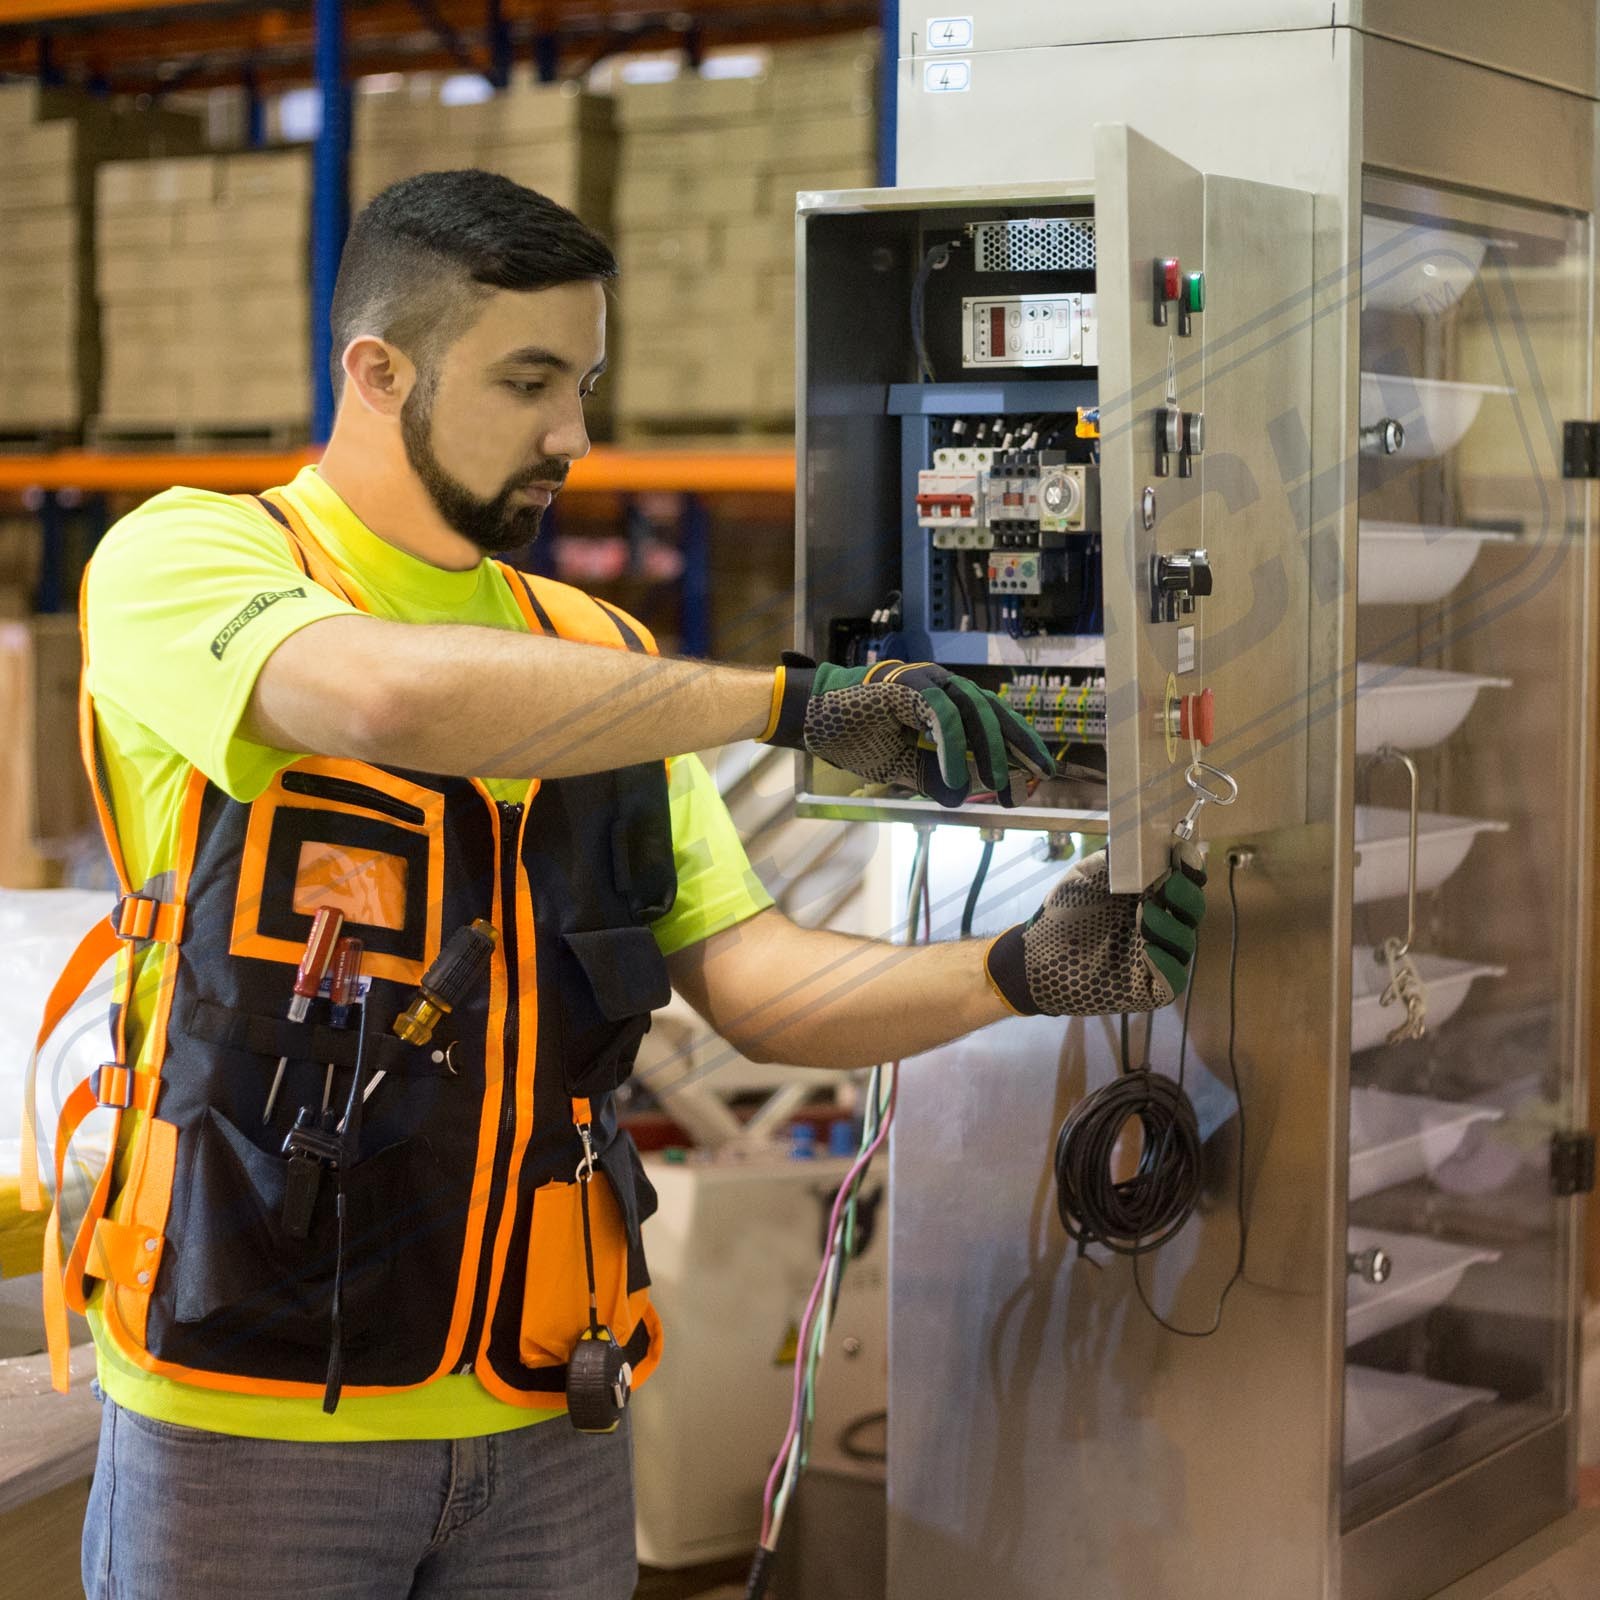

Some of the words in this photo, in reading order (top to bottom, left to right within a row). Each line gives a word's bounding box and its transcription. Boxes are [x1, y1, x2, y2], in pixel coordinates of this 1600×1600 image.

[943, 23, 954, 42] 4
[940, 68, 950, 90] 4
[213, 591, 304, 655] JORESTECH
